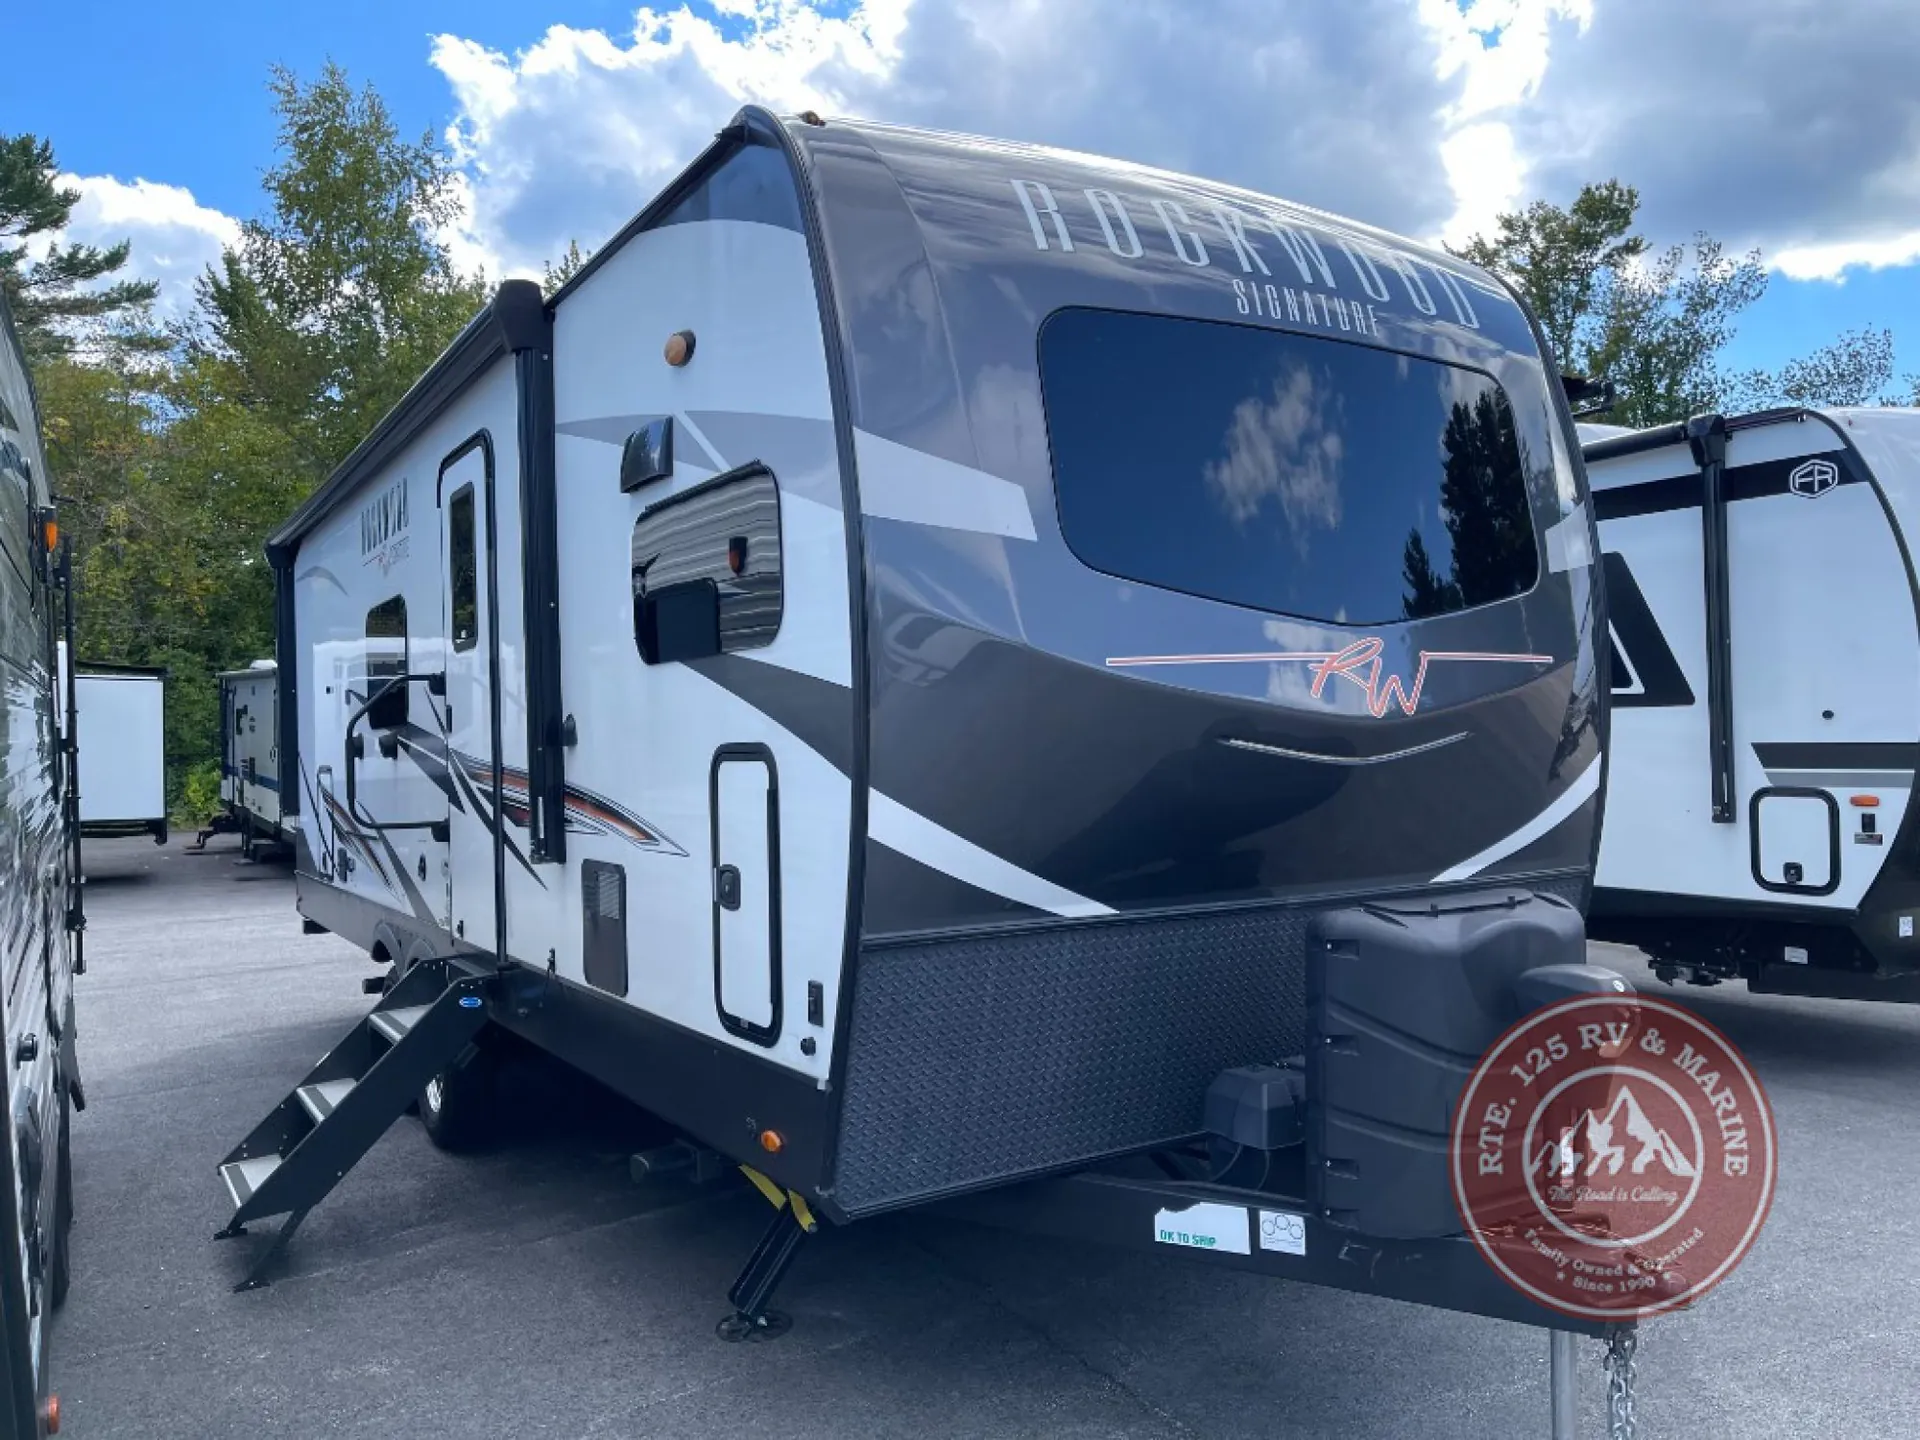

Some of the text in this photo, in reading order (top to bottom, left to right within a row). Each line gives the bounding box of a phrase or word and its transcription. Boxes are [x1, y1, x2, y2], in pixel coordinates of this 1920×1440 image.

[1011, 179, 1481, 330] ROCKWOOD
[1232, 278, 1381, 338] SIGNATURE
[1308, 637, 1428, 718] RW
[1160, 1229, 1216, 1247] OK TO SHIP
